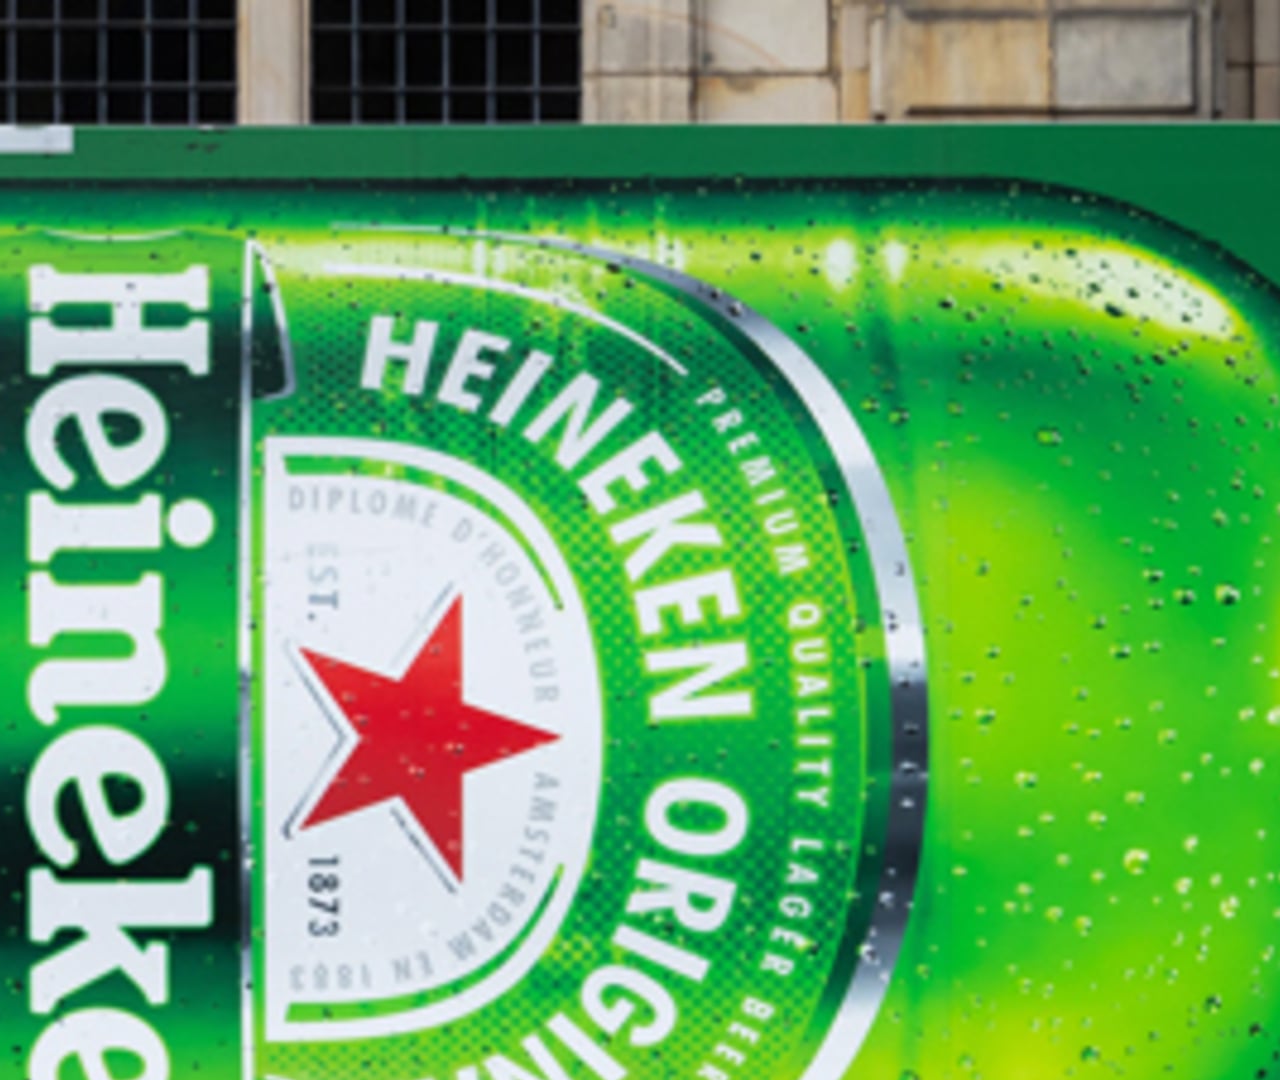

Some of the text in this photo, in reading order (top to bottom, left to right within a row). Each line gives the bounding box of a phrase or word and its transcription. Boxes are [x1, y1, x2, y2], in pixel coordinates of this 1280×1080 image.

[360, 314, 753, 722] HEINEKEN
[695, 385, 810, 576] PREMIUM
[788, 602, 834, 808] QUALITY
[307, 855, 342, 939] 1873
[446, 771, 562, 963] AMSTERDAM
[761, 835, 824, 979] LAGER
[392, 950, 435, 984] EN
